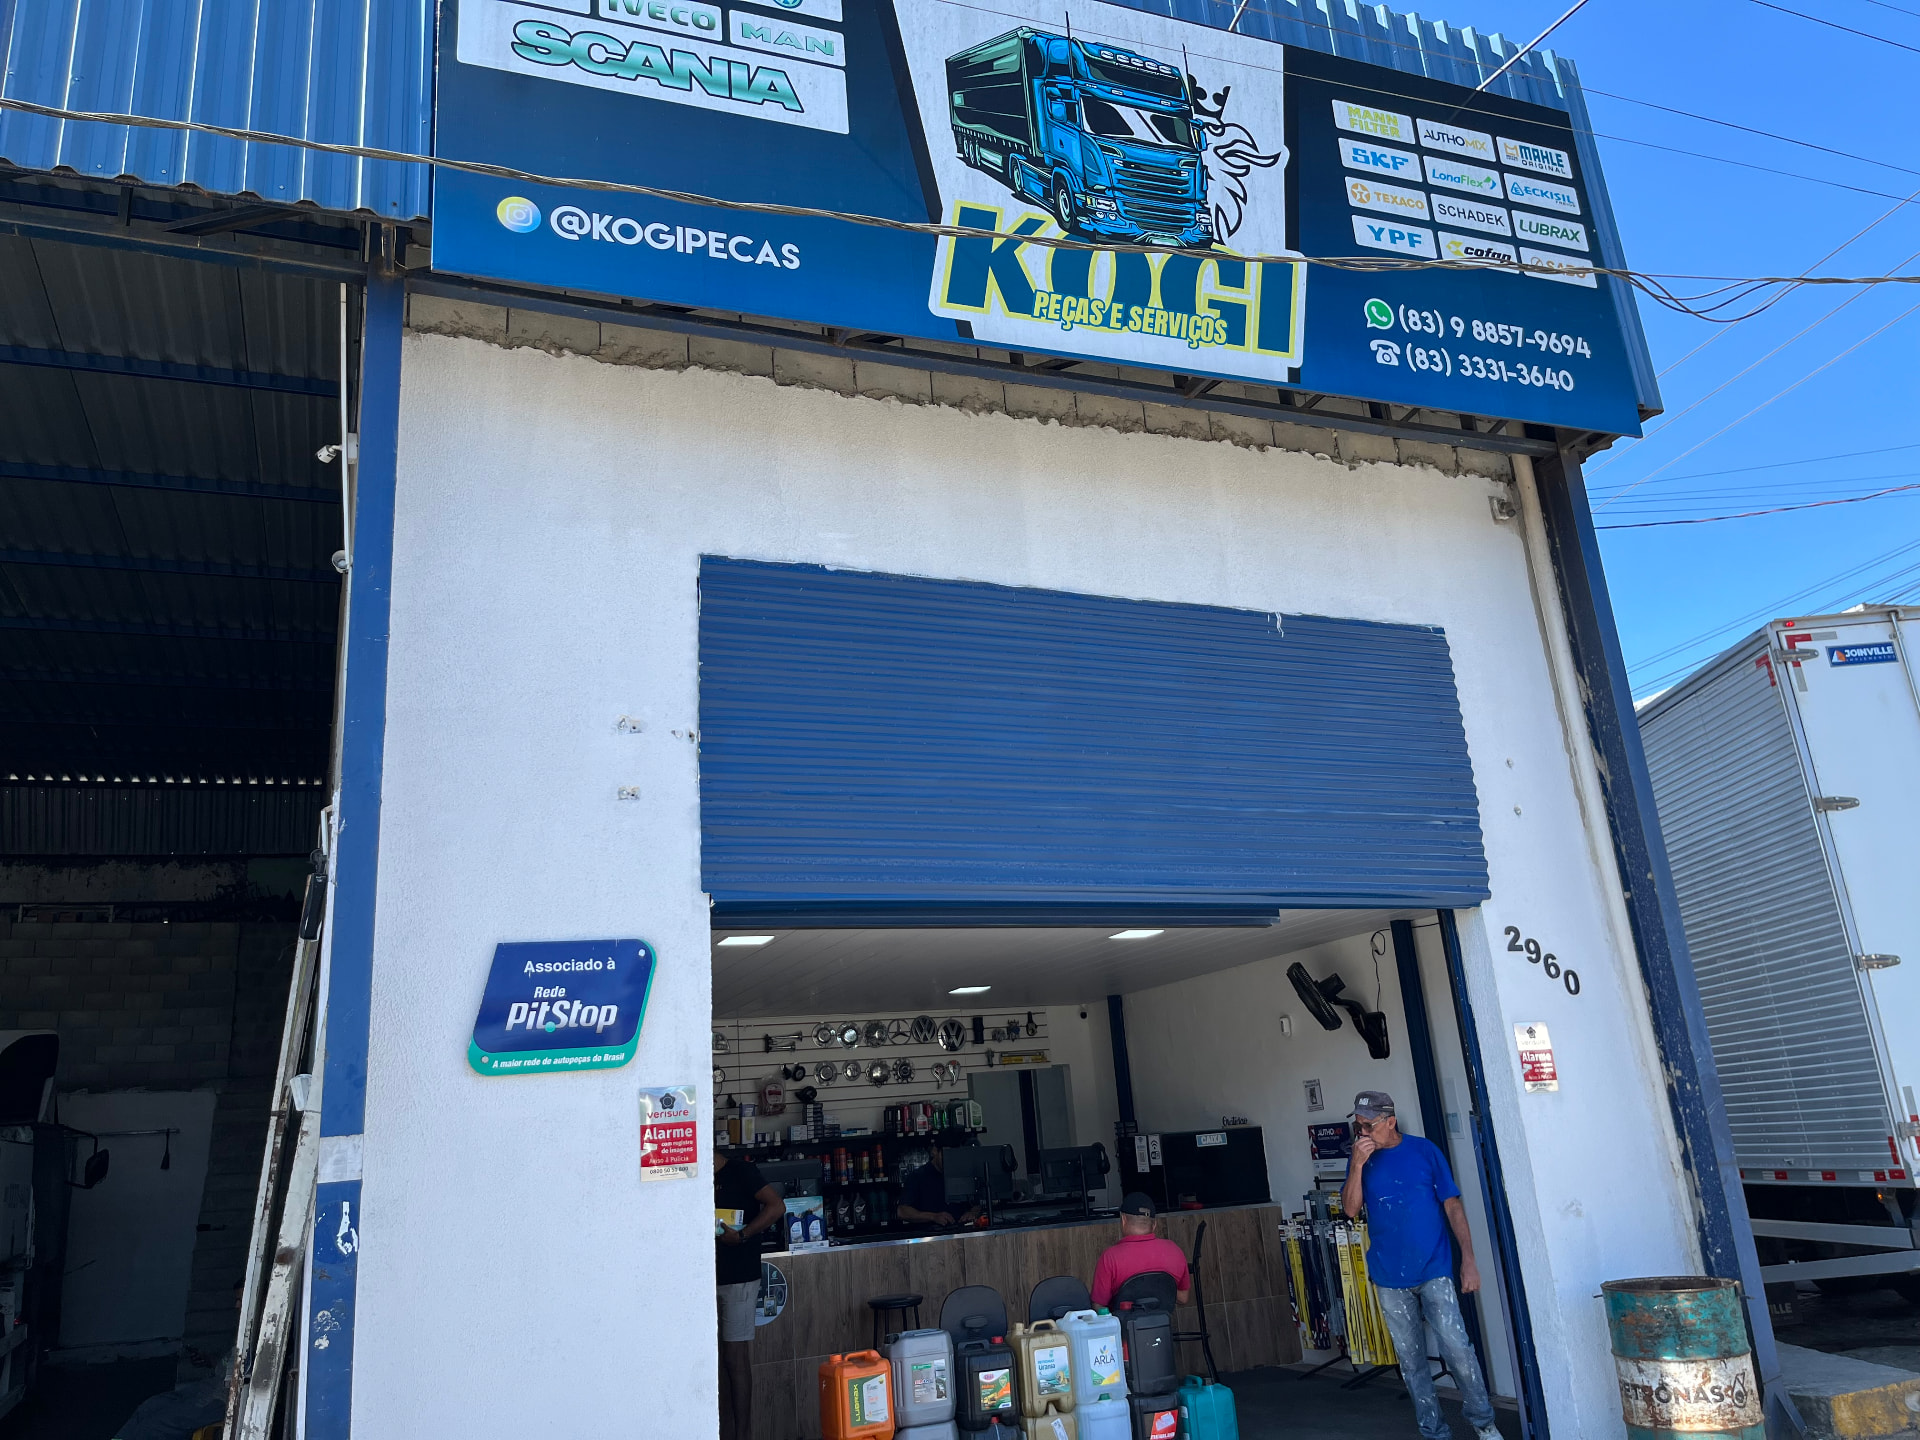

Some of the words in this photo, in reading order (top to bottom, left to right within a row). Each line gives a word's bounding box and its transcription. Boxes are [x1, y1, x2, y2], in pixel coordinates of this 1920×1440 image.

[608, 0, 716, 31] IVECO
[741, 22, 835, 57] MAN
[511, 19, 804, 113] SCANIA
[1347, 105, 1399, 126] MANN
[1349, 117, 1401, 138] FILTER
[1423, 129, 1487, 152] AUTHOMIX
[1352, 147, 1409, 171] SKF
[1519, 145, 1564, 168] MAHLE
[1521, 159, 1566, 175] ORIGINAL
[1432, 169, 1483, 189] LonaFlex
[1374, 191, 1425, 210] TEXACO
[1524, 186, 1574, 204] ECKISIL
[1438, 203, 1505, 227] SCHADEK
[549, 205, 801, 270] @KOGIPECAS
[1367, 224, 1422, 248] YPF
[1519, 219, 1581, 243] LUBRAX
[940, 199, 1296, 358] KOGI
[1033, 291, 1106, 330] PEÇAS
[1111, 302, 1124, 329] E
[1129, 308, 1227, 348] SERVIÇOS
[1399, 304, 1444, 339] (83)
[1450, 316, 1465, 338] 9
[1471, 319, 1592, 359] 8857-9694
[1405, 342, 1452, 377] (83)
[1458, 354, 1575, 392] 3331-3640
[1844, 646, 1894, 658] JOINVILLE
[524, 958, 603, 973] Associado
[606, 957, 616, 970] à
[1504, 925, 1581, 996] 2960
[533, 985, 566, 998] Rede
[505, 1000, 619, 1034] PitStop
[492, 1060, 499, 1068] A
[500, 1059, 522, 1068] maior
[523, 1057, 540, 1066] rede
[542, 1056, 552, 1065] de
[553, 1054, 591, 1065] autopeças
[592, 1053, 602, 1062] do
[603, 1052, 625, 1061] Brasil
[646, 1109, 690, 1119] verisure
[644, 1126, 693, 1140] Alarme
[1200, 1134, 1223, 1145] CAIXA
[669, 1146, 694, 1154] imagens
[1094, 1353, 1116, 1366] ARLA
[853, 1383, 861, 1422] LUBRAX
